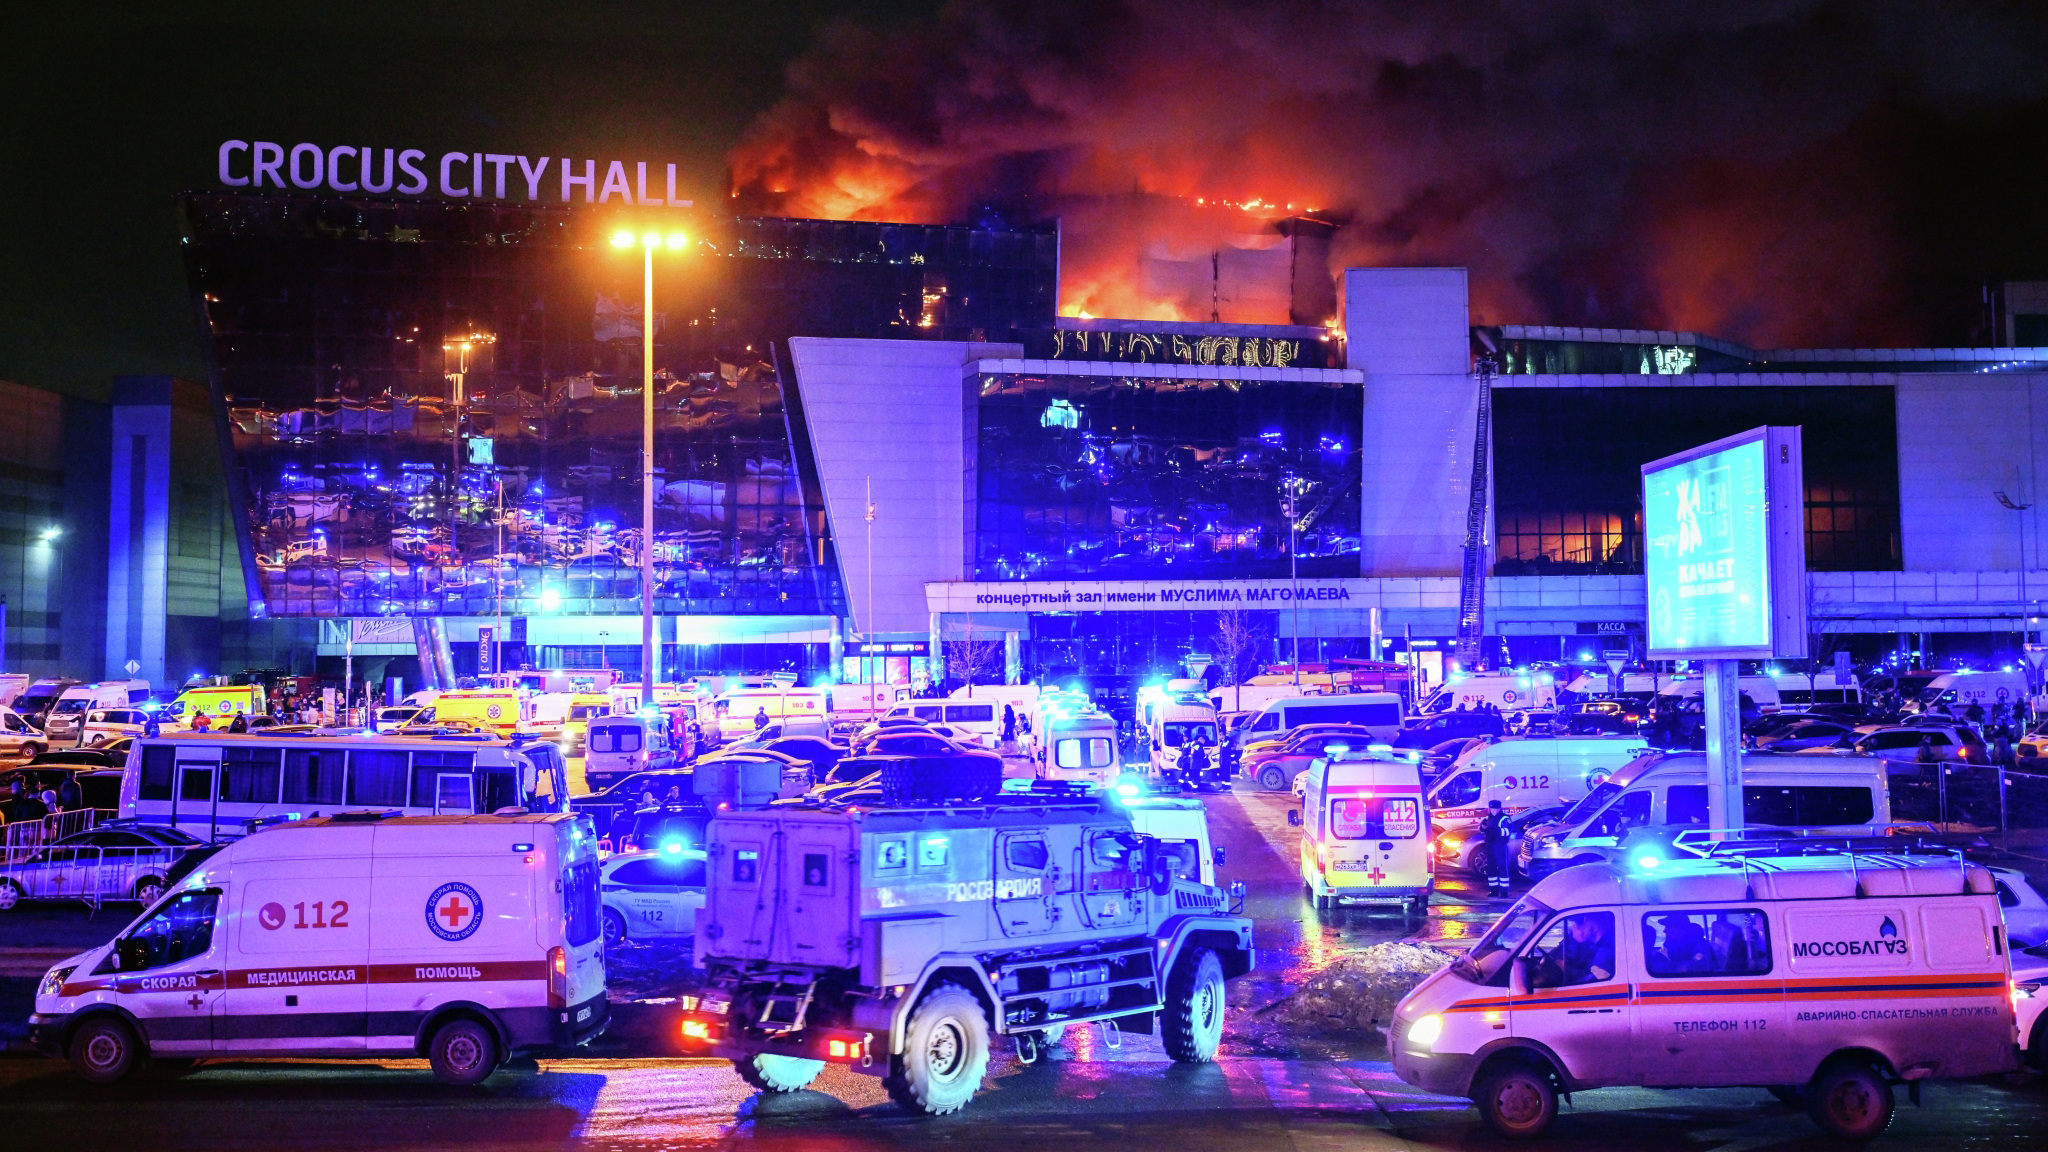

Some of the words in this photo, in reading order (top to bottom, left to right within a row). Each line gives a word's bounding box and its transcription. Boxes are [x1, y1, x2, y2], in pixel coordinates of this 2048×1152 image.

[218, 139, 429, 195] CROCUS
[440, 151, 550, 201] CITY
[561, 157, 694, 208] HALL
[1679, 558, 1735, 584] КАЧАЕТ
[976, 590, 1071, 606] концертный
[1075, 592, 1101, 602] зал
[1107, 591, 1156, 602] имени
[1160, 589, 1241, 602] МУСЛИМА
[1246, 587, 1350, 601] МАГОМАЕВА
[1597, 622, 1626, 631] КАССА
[1520, 775, 1549, 789] 112
[1384, 806, 1415, 822] 112
[1446, 810, 1475, 818] СКОРАЯ
[429, 884, 452, 907] СКОРАЯ
[453, 884, 480, 906] ПОМОЩЬ
[947, 878, 1041, 902] РОСГВАРДИЯ
[293, 900, 349, 929] 112
[641, 910, 663, 921] 112
[427, 912, 460, 940] МОСКОВСКАЯ
[461, 911, 481, 938] ОБЛАСТЬ
[141, 976, 197, 990] СКОРАЯ
[247, 969, 356, 985] МЕДИЦИНСКАЯ
[415, 966, 482, 980] ПОМОЩЬ
[1796, 1008, 1948, 1022] АВАРИЙНО-СПАСАТЕЛЬНАЯ
[1951, 1006, 1999, 1017] СЛУЖБА
[1673, 1020, 1739, 1032] ТЕЛЕФОН
[1744, 1019, 1767, 1030] 112
